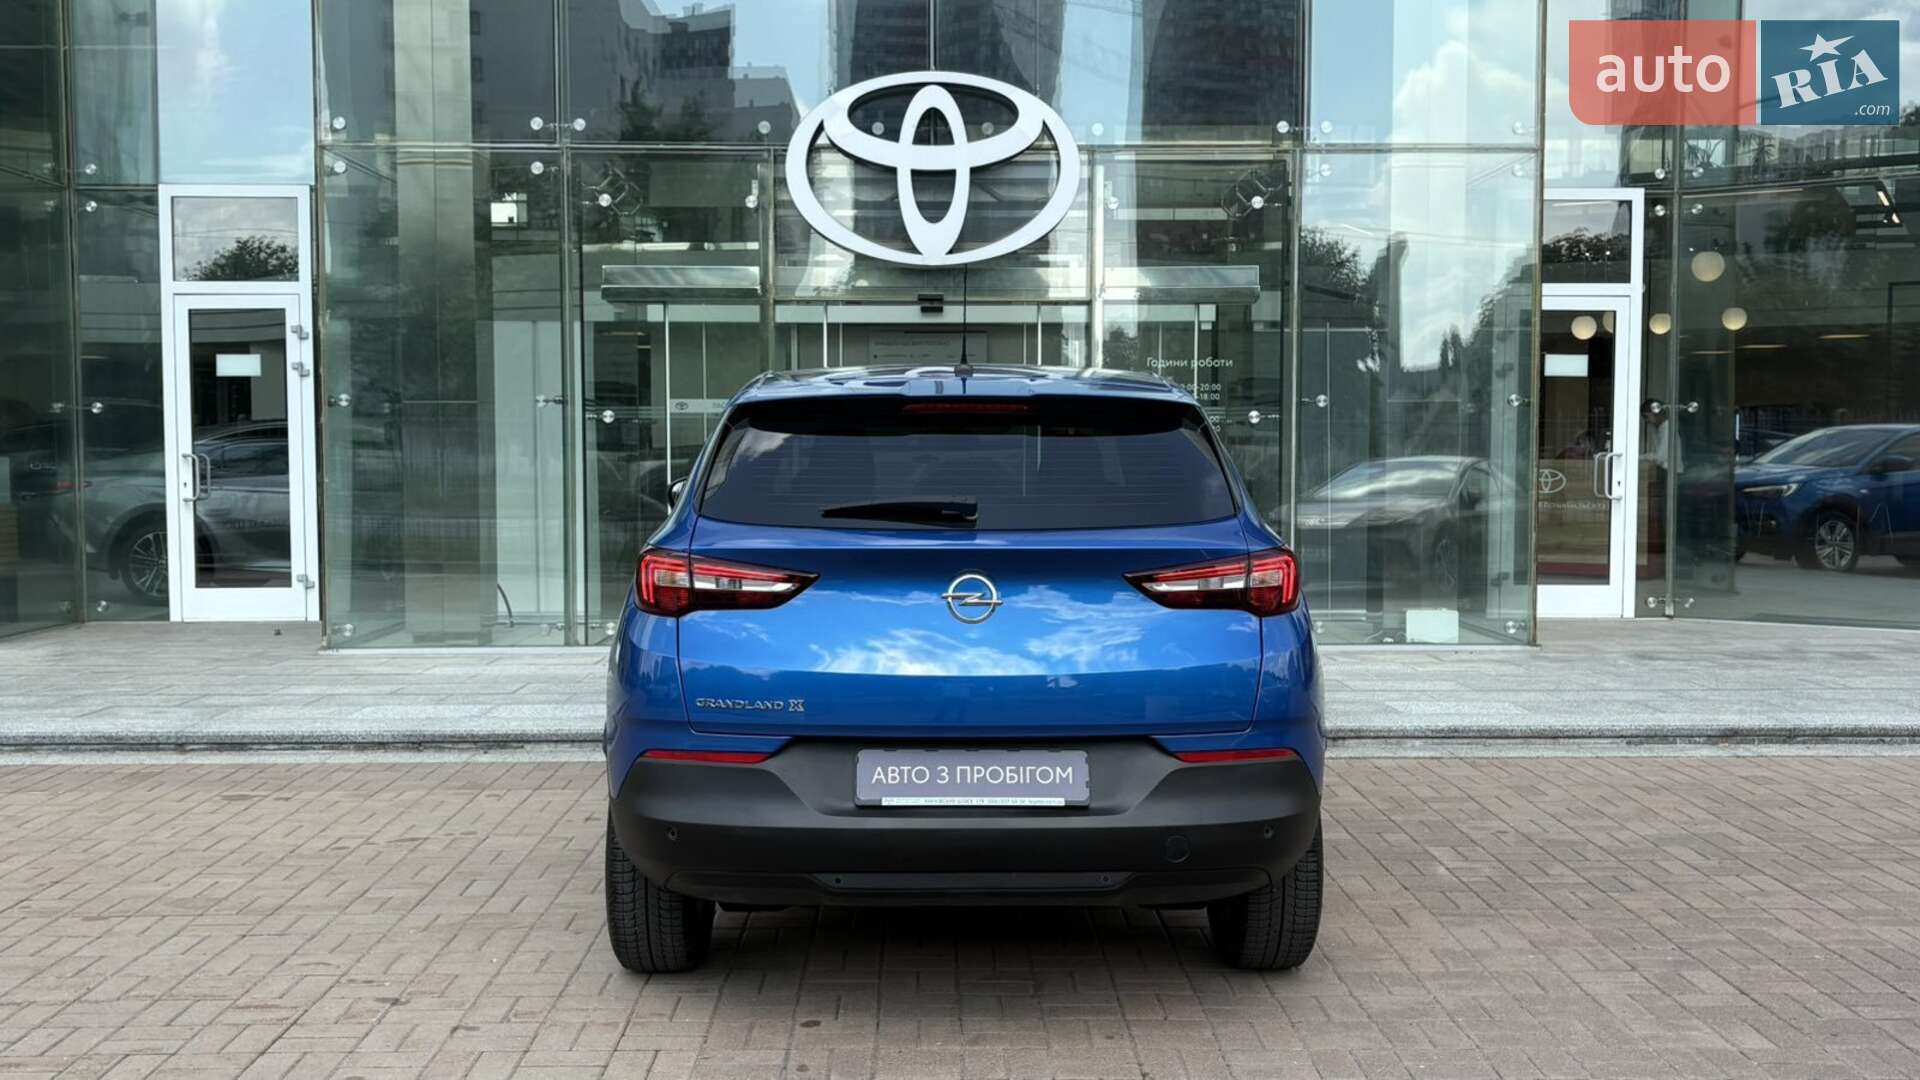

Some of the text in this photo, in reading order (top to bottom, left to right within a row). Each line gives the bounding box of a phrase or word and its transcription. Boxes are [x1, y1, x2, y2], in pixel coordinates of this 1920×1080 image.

[1146, 356, 1233, 368] Години роботи
[696, 698, 805, 712] GRANDLAND X
[871, 766, 930, 784] АВТО
[957, 766, 1073, 784] ПРОБІГОМ
